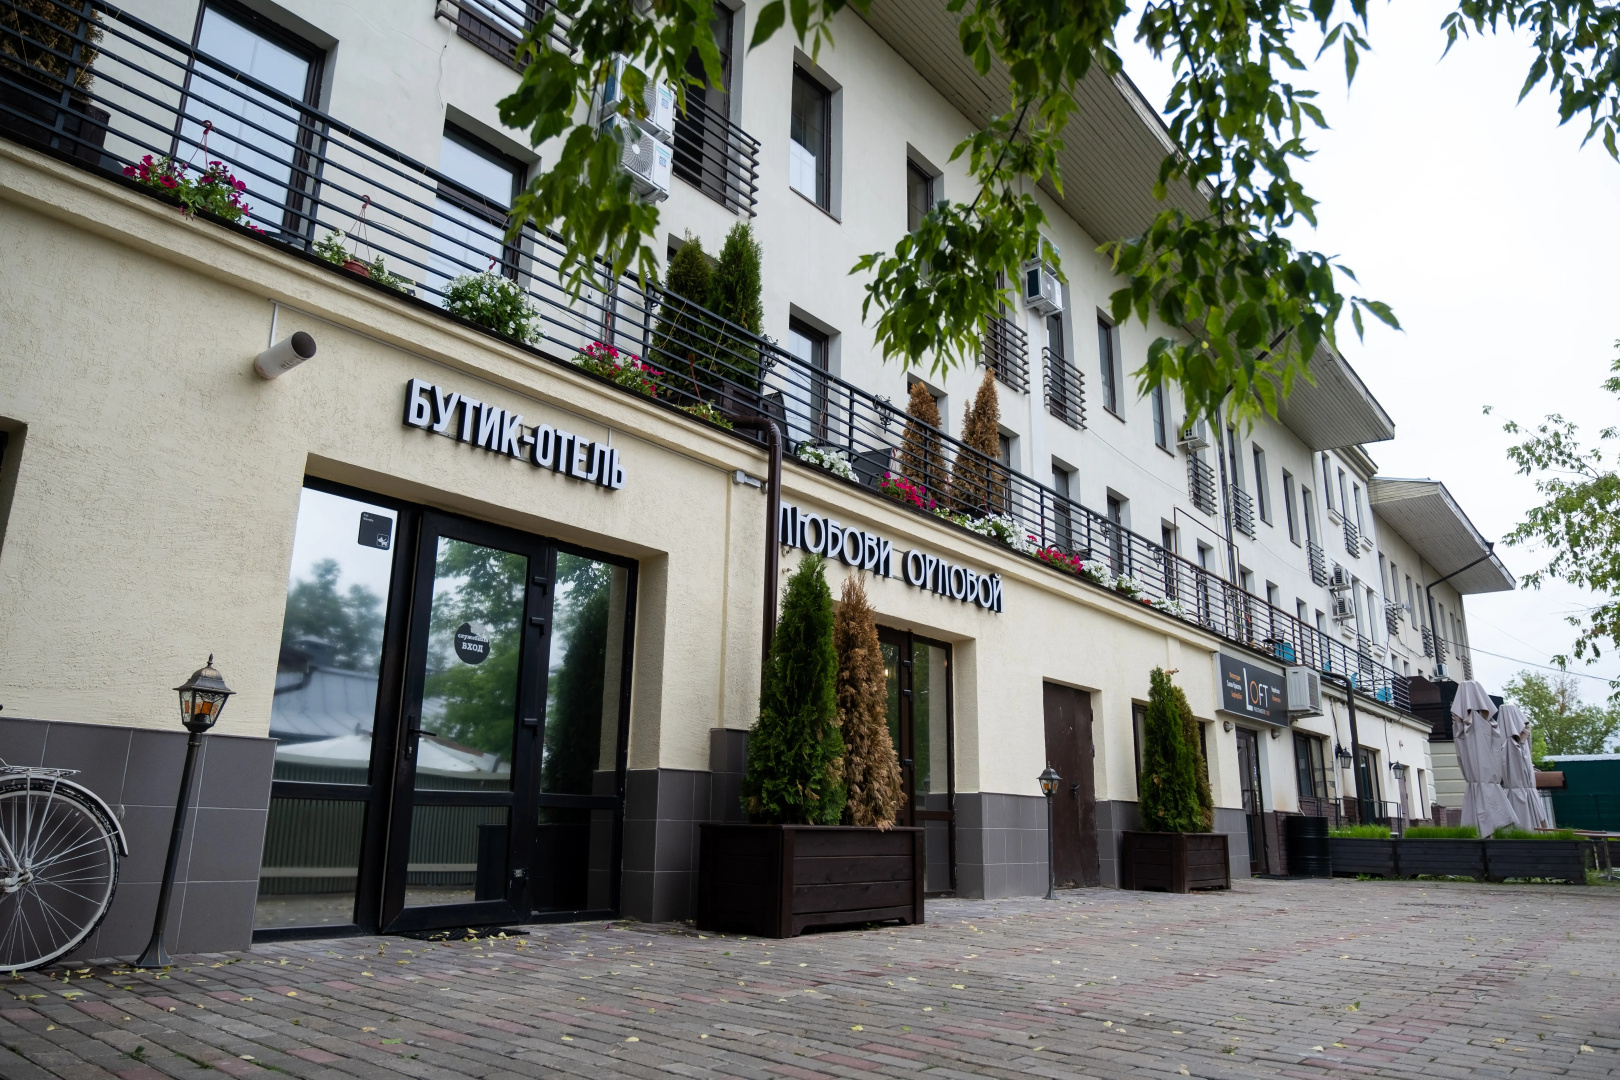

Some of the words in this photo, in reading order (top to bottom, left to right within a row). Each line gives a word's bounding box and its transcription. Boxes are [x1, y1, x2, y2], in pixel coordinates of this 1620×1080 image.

[404, 378, 627, 490] БУТИК-ОТЕЛЬ
[779, 501, 893, 578] ЛЮБОВИ
[902, 549, 1003, 613] ОРЛОВОЙ
[461, 641, 484, 653] ВХОД
[1242, 667, 1269, 711] LOFT
